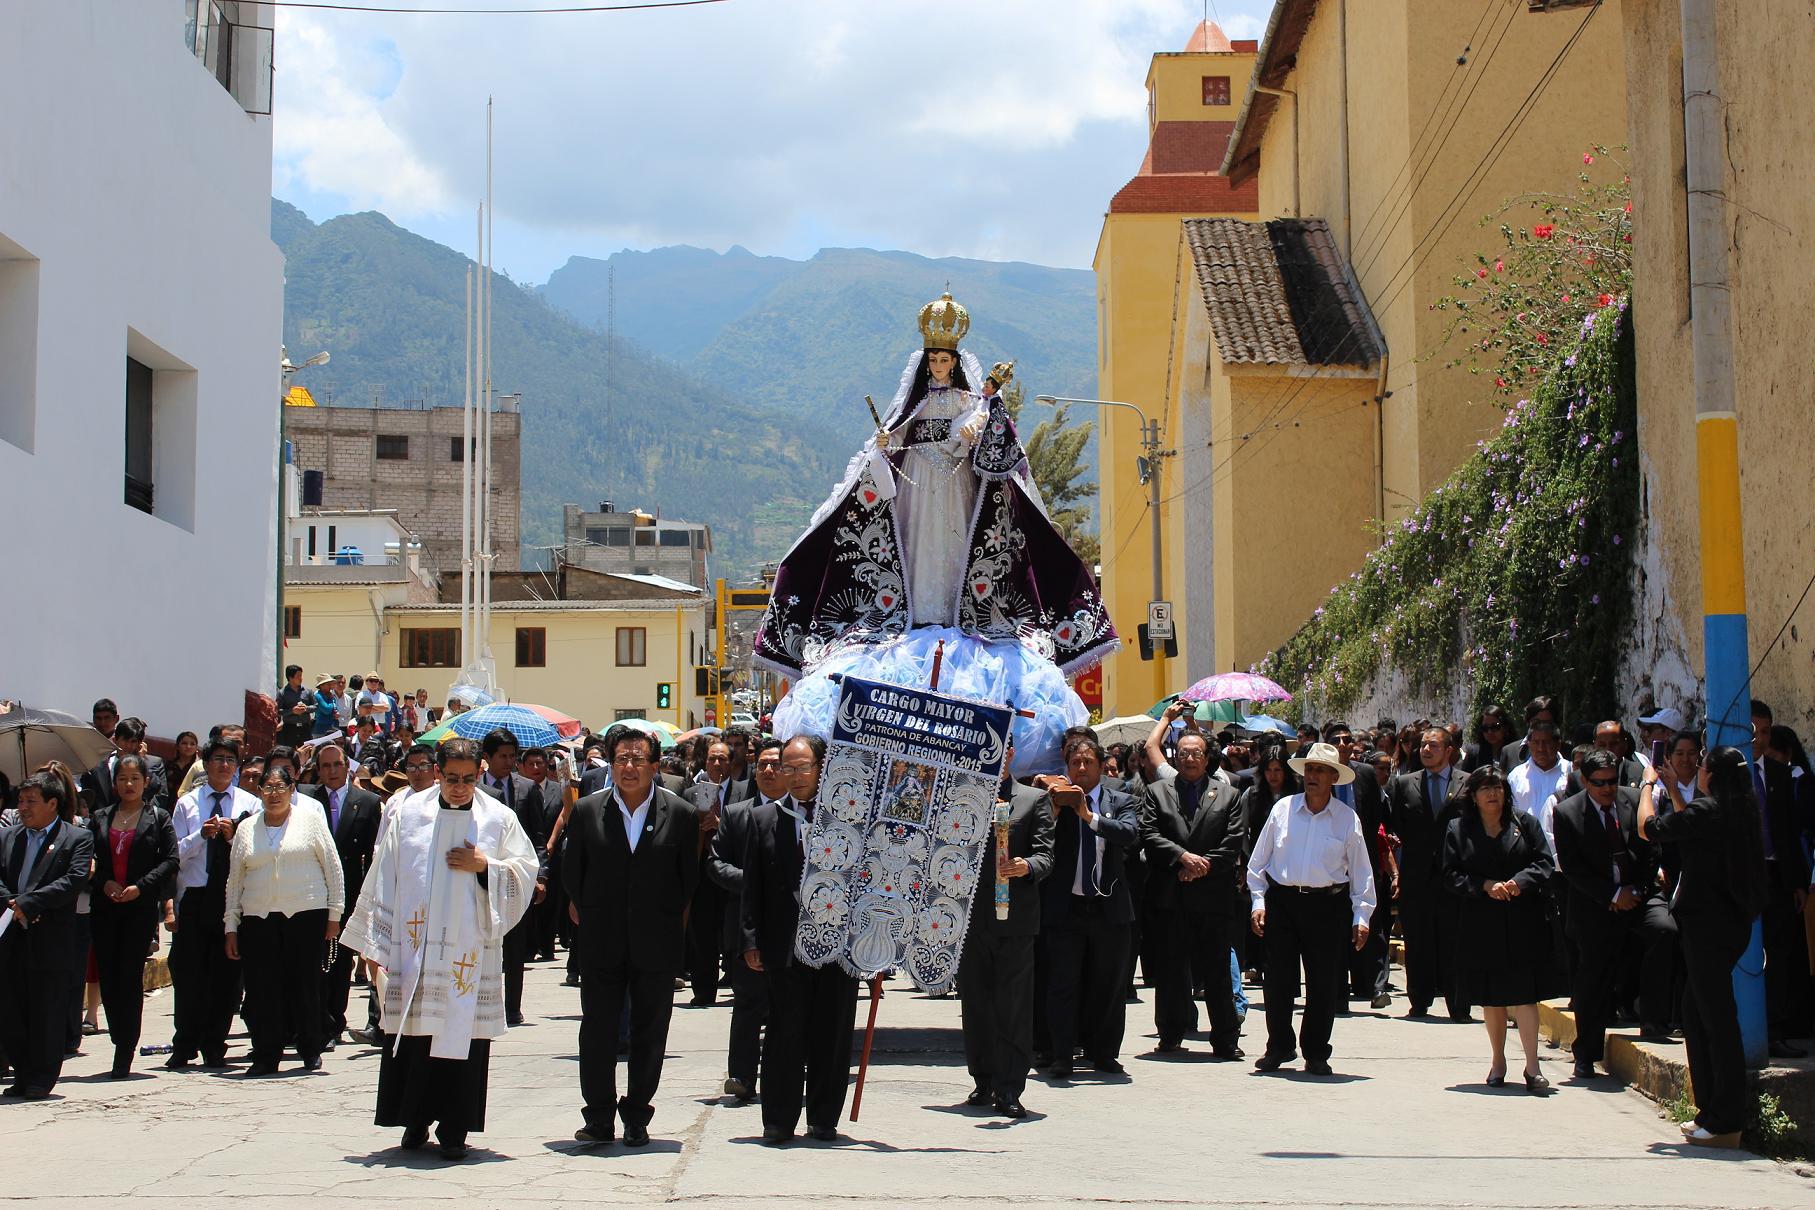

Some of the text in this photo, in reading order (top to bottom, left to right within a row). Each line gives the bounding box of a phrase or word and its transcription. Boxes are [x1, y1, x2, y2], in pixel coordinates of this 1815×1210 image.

[1156, 608, 1164, 619] E
[870, 688, 975, 724] CARGO MAYOR
[853, 703, 987, 745] VIRGEN DEL ROSARIO
[864, 723, 967, 752] PATRONA DE ABANCAY
[855, 732, 906, 753] GOBIERNO
